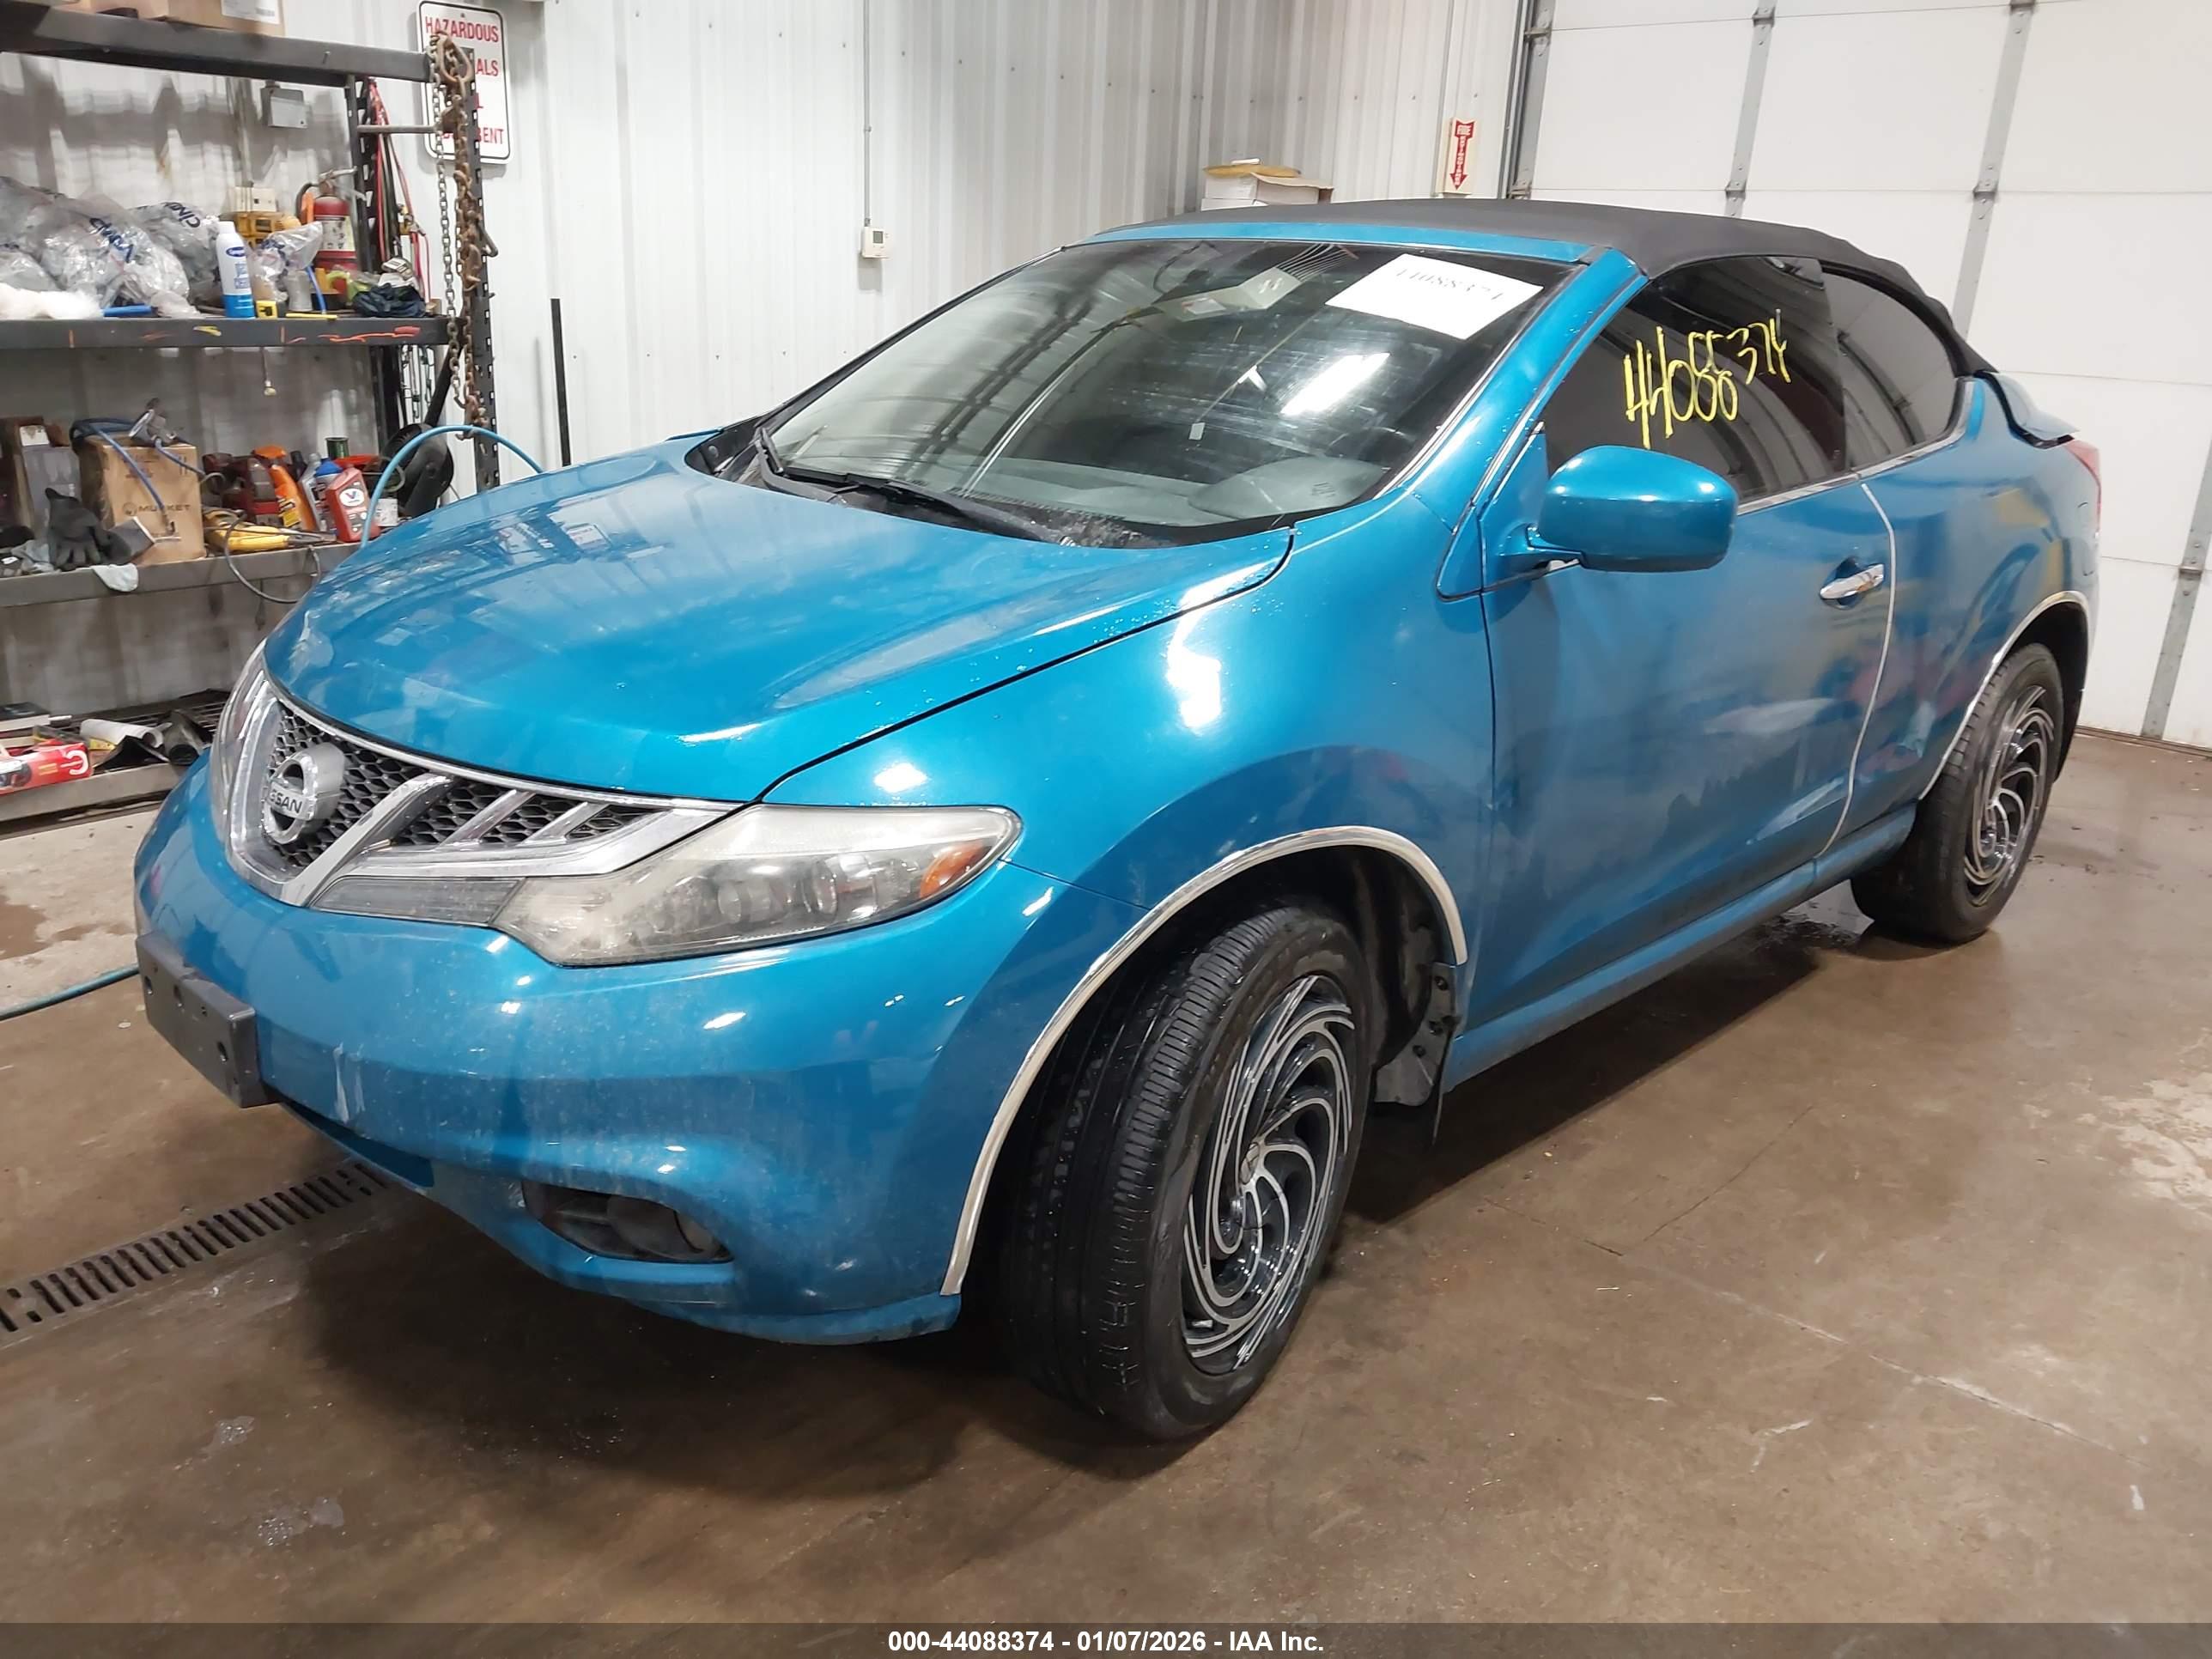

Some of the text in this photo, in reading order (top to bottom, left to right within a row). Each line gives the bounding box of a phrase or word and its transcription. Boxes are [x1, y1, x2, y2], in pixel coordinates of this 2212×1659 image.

[425, 15, 499, 43] HAZARDOUS
[1623, 308, 1792, 450] 44088374
[138, 503, 191, 513] MUKET
[268, 789, 302, 814] SSAN
